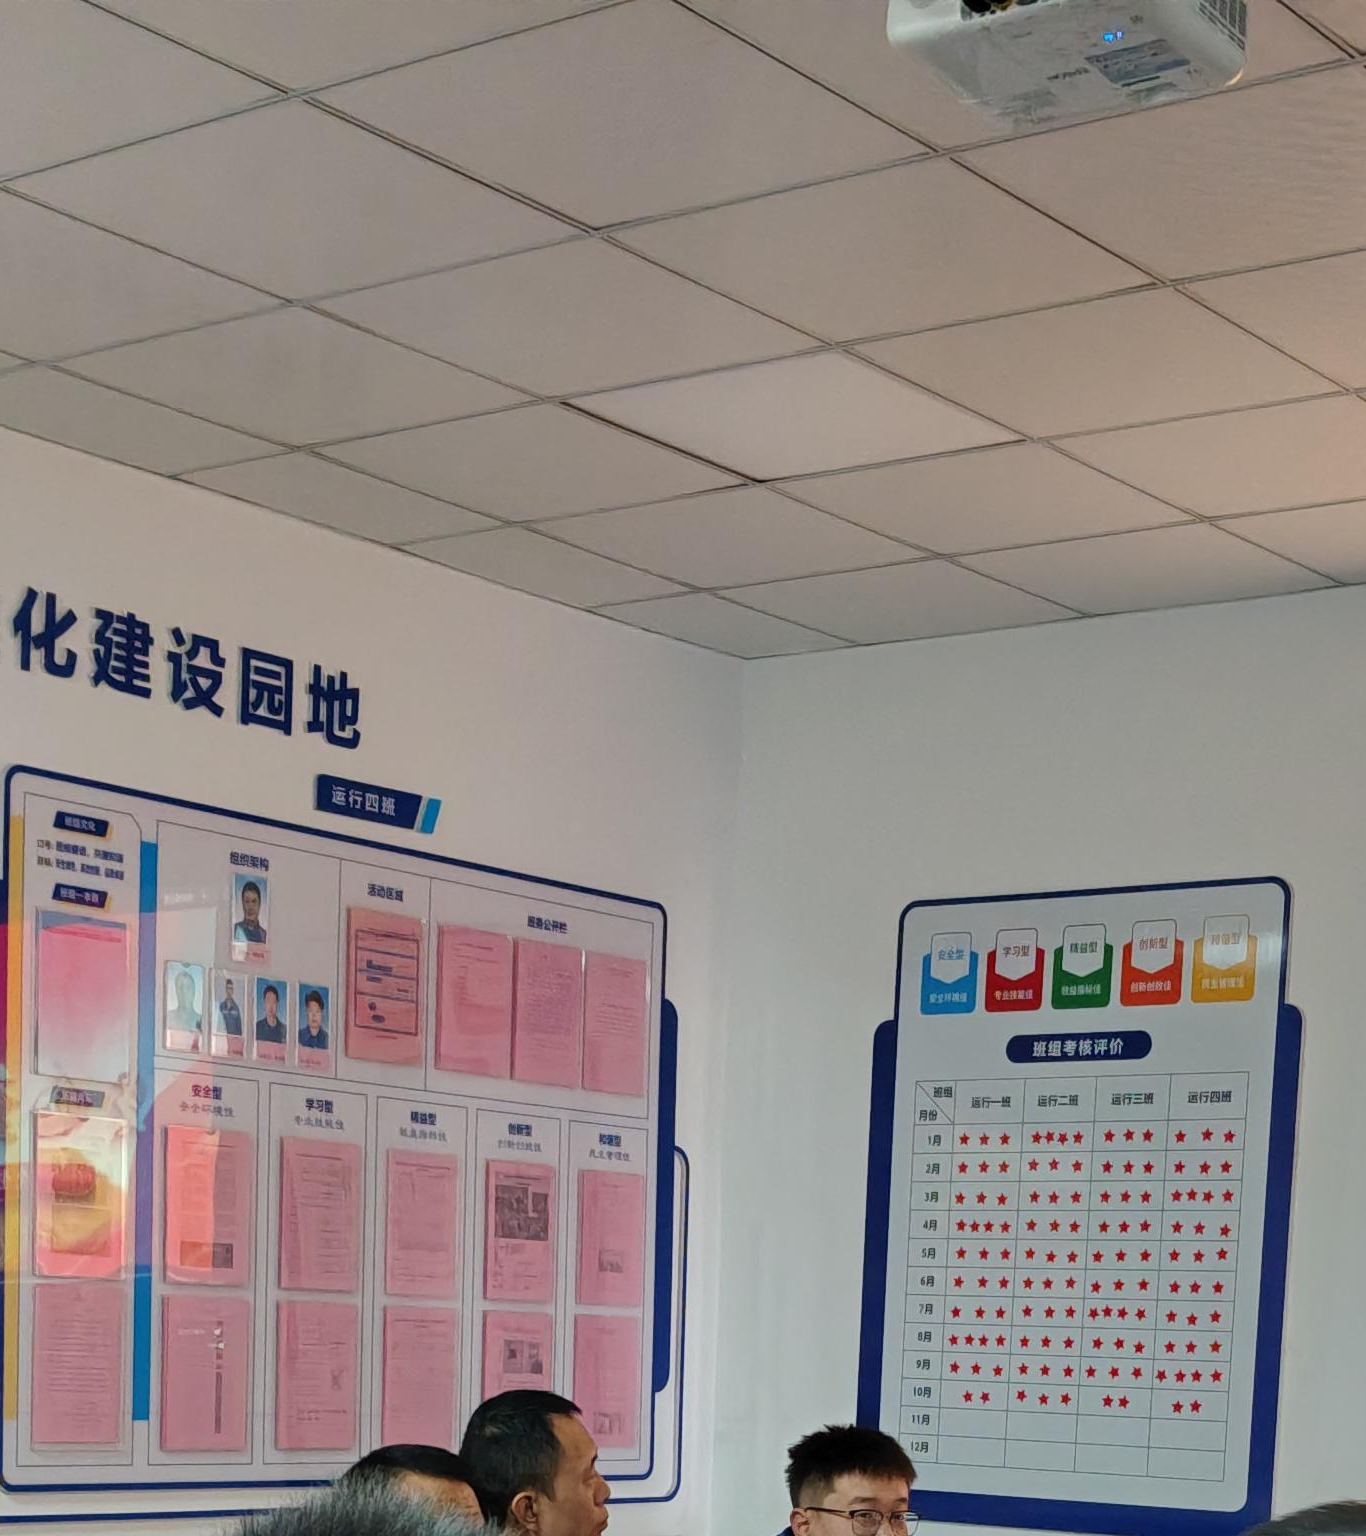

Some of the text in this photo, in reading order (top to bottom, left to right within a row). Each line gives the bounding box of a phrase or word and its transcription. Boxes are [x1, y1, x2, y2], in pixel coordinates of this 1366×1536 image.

[331, 784, 396, 817] 运行四班
[229, 850, 269, 872] 组织架构
[1139, 936, 1169, 950] 创新型
[1002, 944, 1030, 958] 学习型
[1031, 1037, 1125, 1058] 班组考核评价
[190, 1084, 223, 1101] 安全型
[933, 1086, 954, 1098] 班组
[1187, 1090, 1232, 1104] 运行四班
[970, 1095, 1012, 1109] 运行一班
[1037, 1094, 1080, 1108] 运行二班
[1111, 1092, 1155, 1106] 运行三班
[305, 1098, 334, 1114] 学习型
[918, 1109, 938, 1122] 月份
[927, 1134, 942, 1146] 1月
[925, 1162, 940, 1175] 2月
[923, 1191, 939, 1203] 3月
[922, 1219, 938, 1232] 4月
[921, 1247, 936, 1260] 5月
[919, 1275, 935, 1288] 6月
[917, 1303, 934, 1316] 7月
[915, 1358, 931, 1371] 9月
[912, 1386, 932, 1399] 10月
[911, 1413, 931, 1426] 11月
[910, 1441, 929, 1454] 12月
